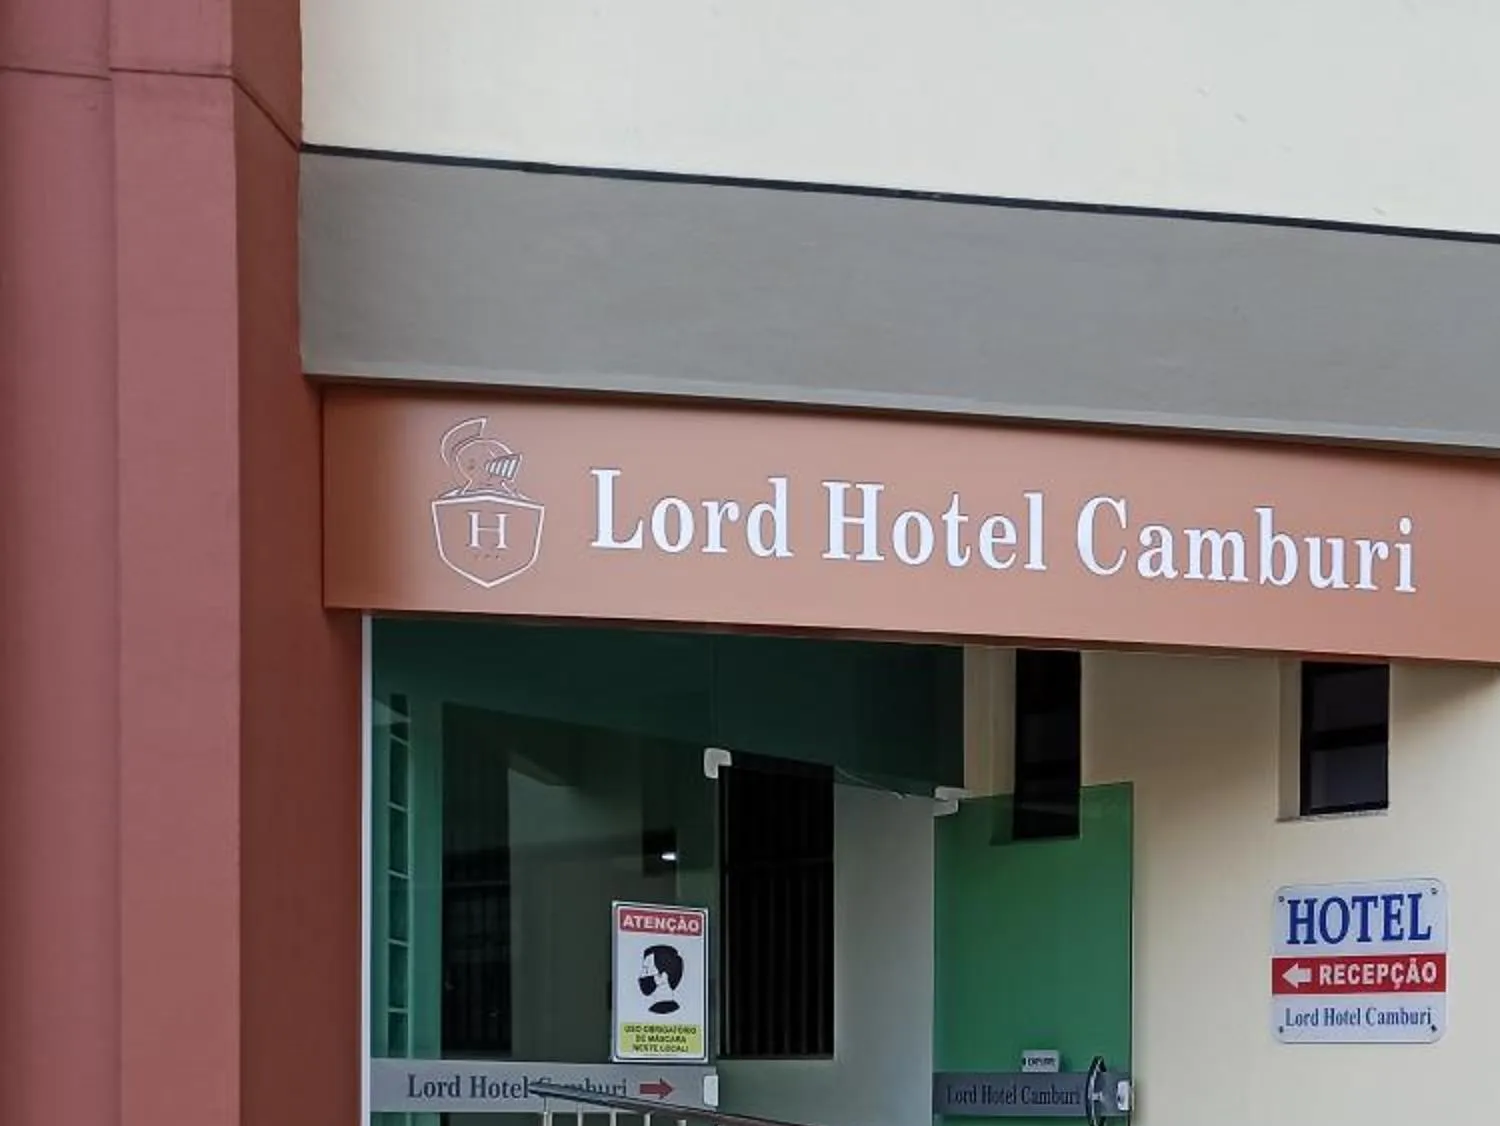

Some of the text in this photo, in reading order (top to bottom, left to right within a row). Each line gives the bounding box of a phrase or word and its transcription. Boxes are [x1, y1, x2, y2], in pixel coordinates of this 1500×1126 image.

[467, 511, 512, 549] H
[590, 468, 1417, 593] Lord Hotel Camburi
[623, 915, 700, 933] ATENÇÃO
[1286, 893, 1432, 945] HOTEL
[1319, 958, 1437, 990] RECEPÇÃO
[1285, 1007, 1432, 1026] Lord Hotel Camburi
[408, 1074, 627, 1099] Lord Hotel buri
[947, 1084, 977, 1104] Lord
[981, 1084, 1018, 1104] Hotel
